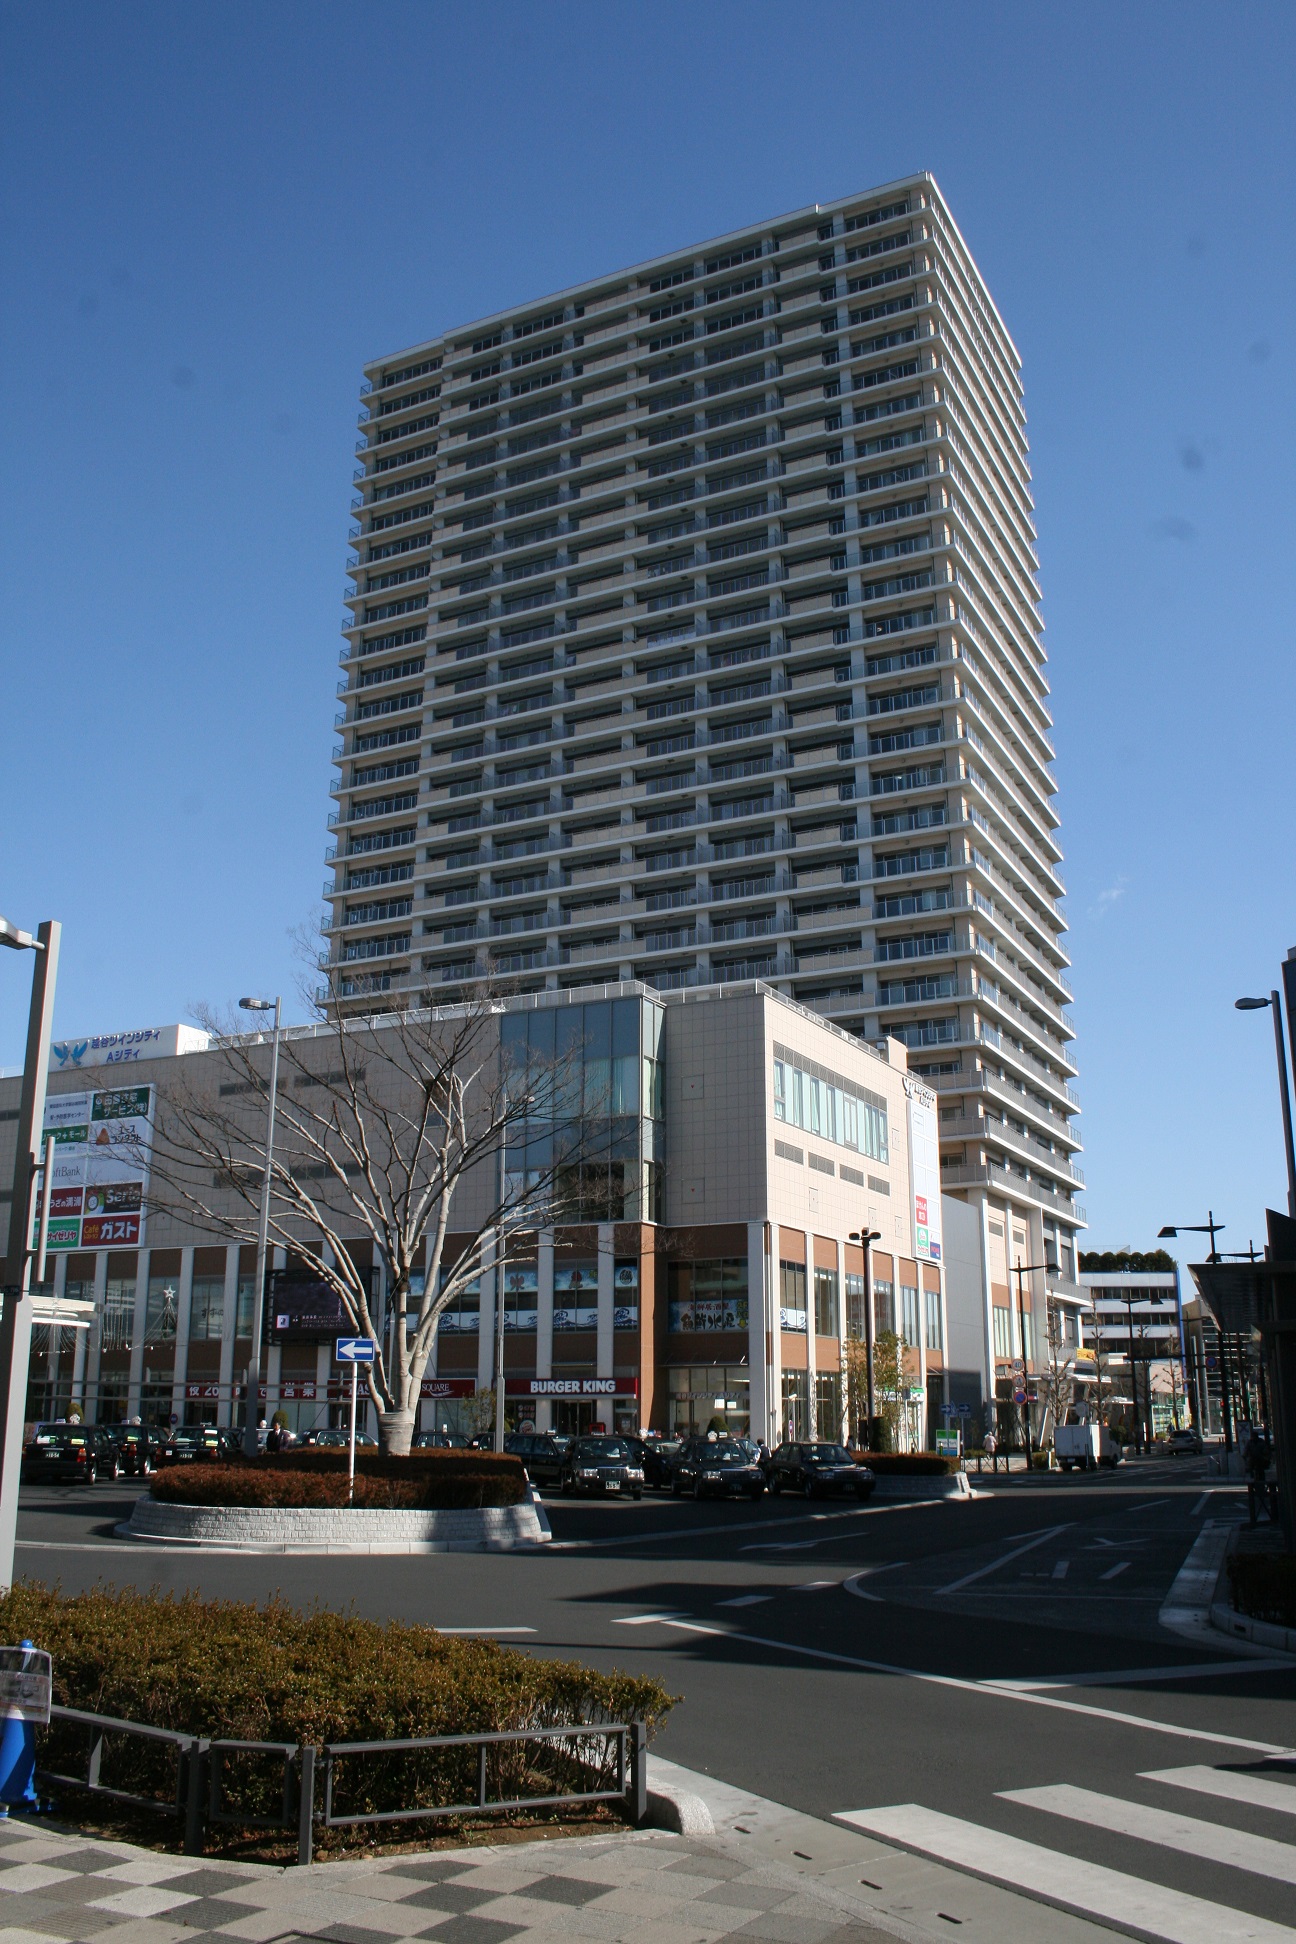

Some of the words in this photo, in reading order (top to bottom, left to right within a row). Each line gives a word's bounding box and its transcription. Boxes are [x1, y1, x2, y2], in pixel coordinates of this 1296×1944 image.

[91, 1030, 161, 1049] 越谷ツインシティ
[106, 1048, 141, 1063] Aシティ
[84, 1224, 99, 1234] Café
[101, 1221, 138, 1240] ガスト
[421, 1383, 450, 1392] SQUARE
[530, 1380, 580, 1393] BURGER
[582, 1380, 616, 1393] KING
